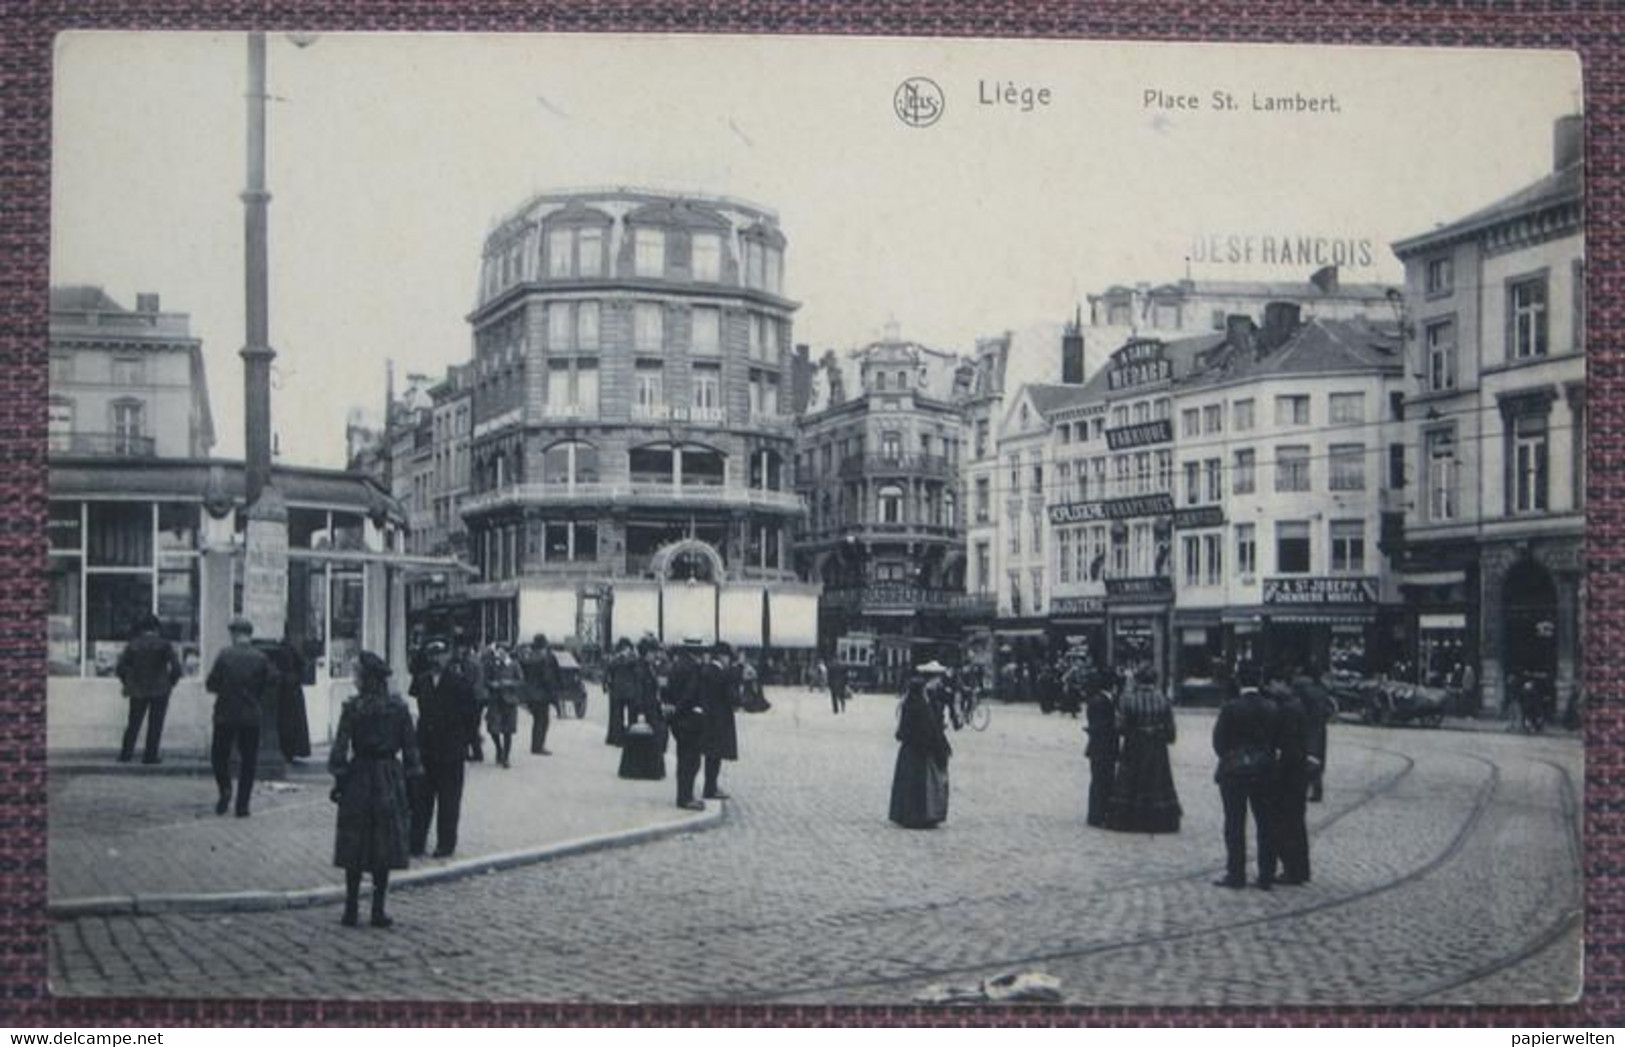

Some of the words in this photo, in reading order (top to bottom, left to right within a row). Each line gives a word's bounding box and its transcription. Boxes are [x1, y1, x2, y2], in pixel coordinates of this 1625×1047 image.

[978, 80, 1052, 112] Liège
[1143, 90, 1200, 110] Place
[1211, 91, 1239, 111] St.
[1251, 92, 1342, 114] Lambert.
[1110, 422, 1169, 449] FABRIQUE
